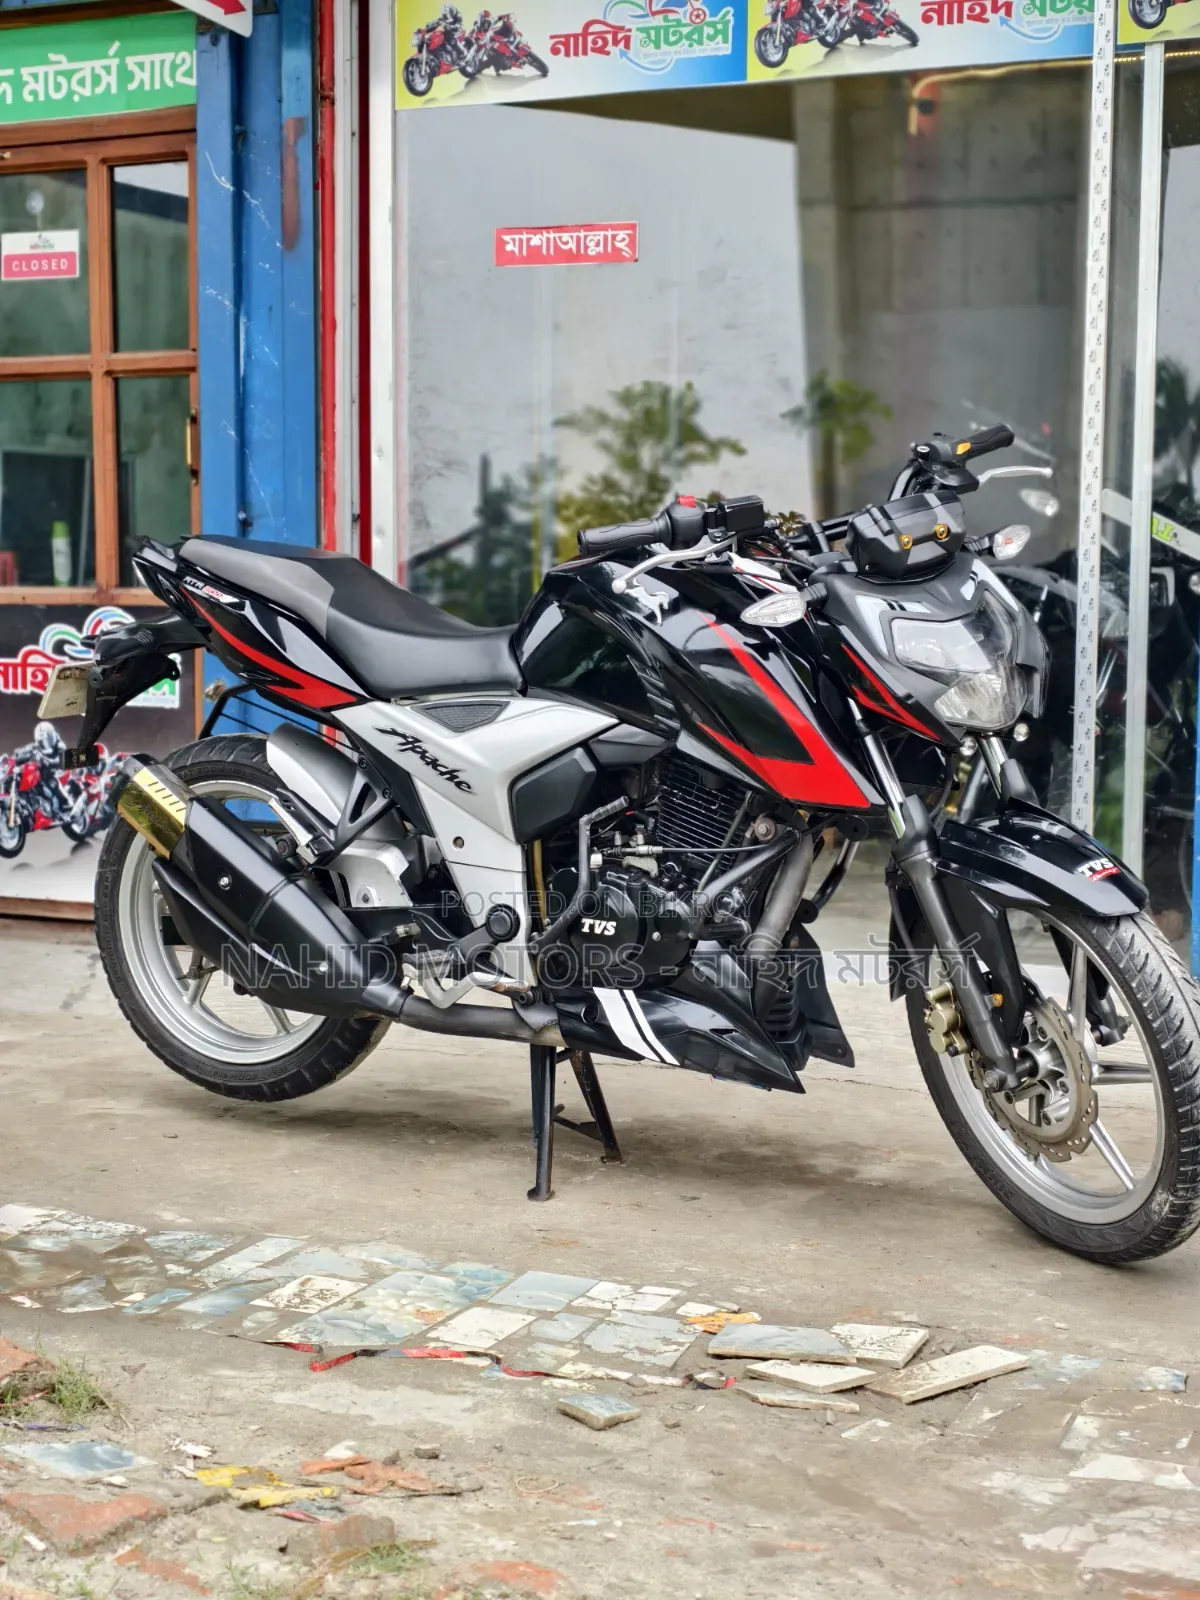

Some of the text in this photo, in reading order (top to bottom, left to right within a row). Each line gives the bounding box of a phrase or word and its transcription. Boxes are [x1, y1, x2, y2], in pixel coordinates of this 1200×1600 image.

[549, 19, 632, 58] নাহিদ
[12, 257, 69, 272] CLOSED
[374, 726, 477, 796] Apache
[1076, 858, 1114, 877] TVS
[581, 917, 617, 936] TVS
